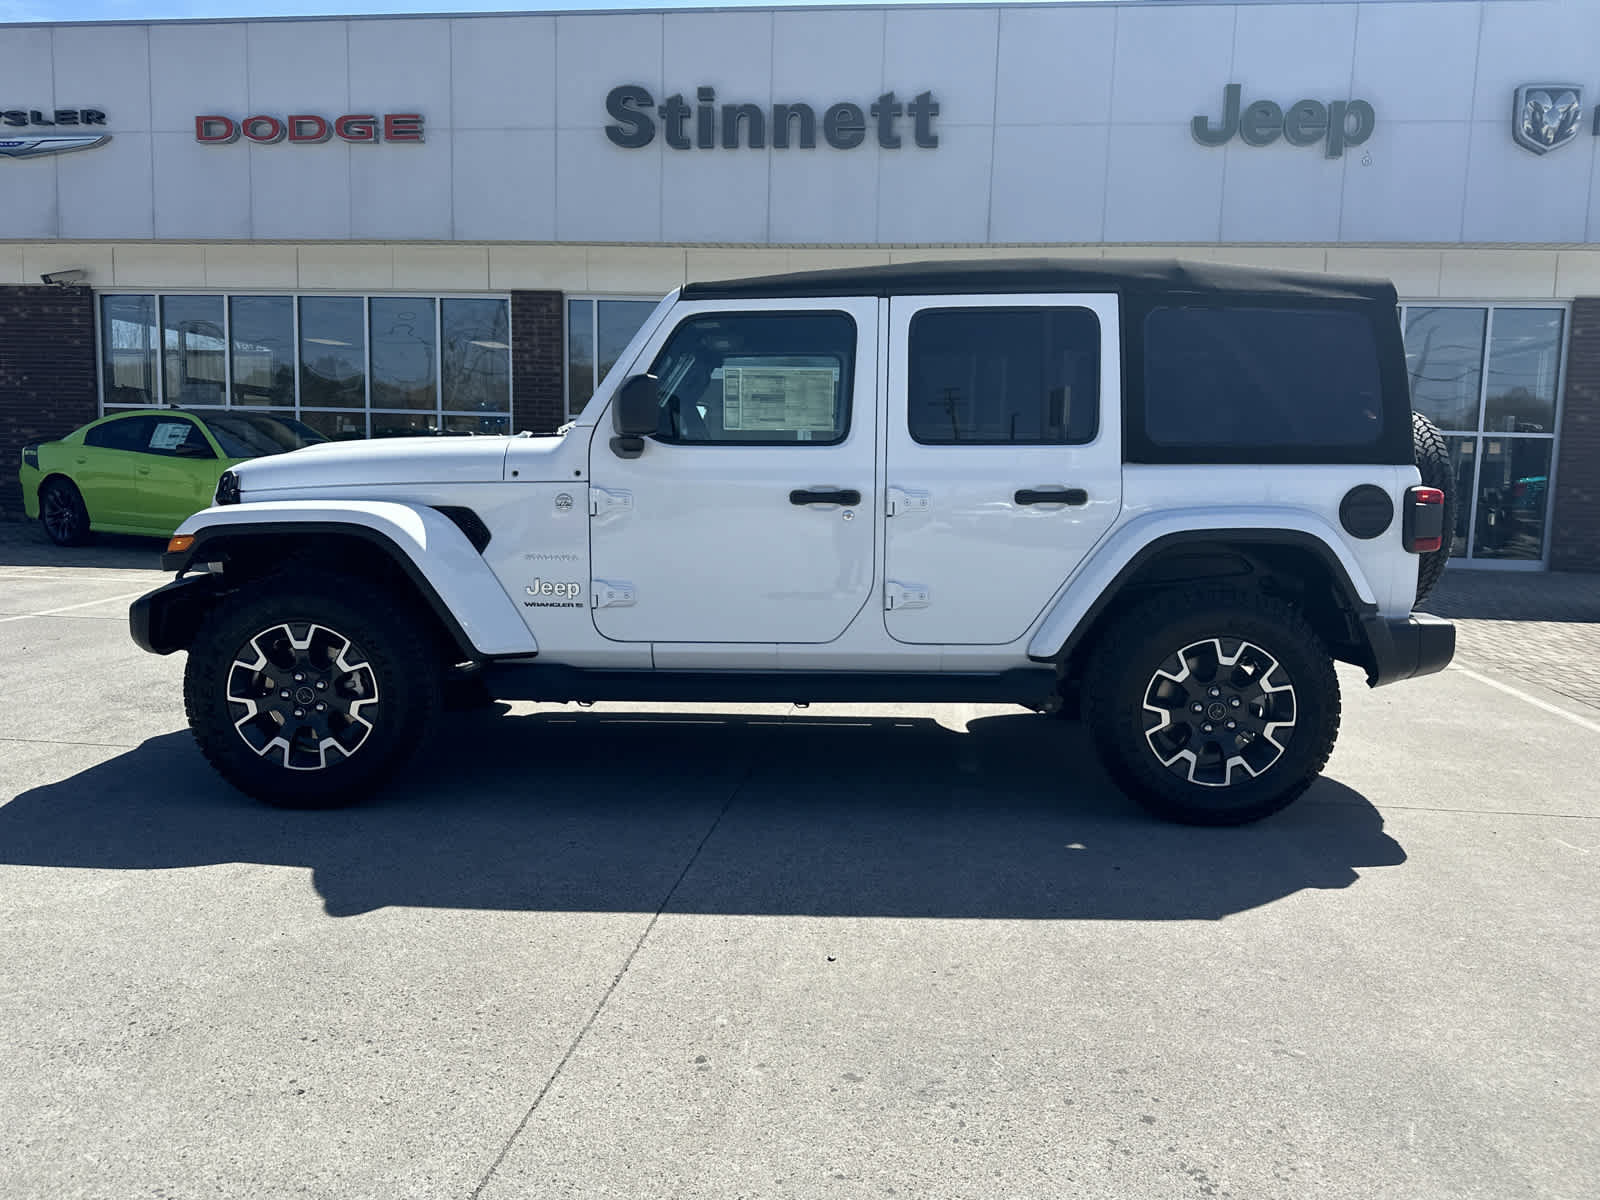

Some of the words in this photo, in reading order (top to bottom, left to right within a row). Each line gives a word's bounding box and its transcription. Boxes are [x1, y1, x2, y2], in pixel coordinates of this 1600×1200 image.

[0, 109, 107, 126] SLER
[195, 114, 425, 144] DODGE
[605, 85, 939, 150] Stinnett
[1191, 83, 1376, 160] Jeep
[525, 577, 581, 600] Jeep
